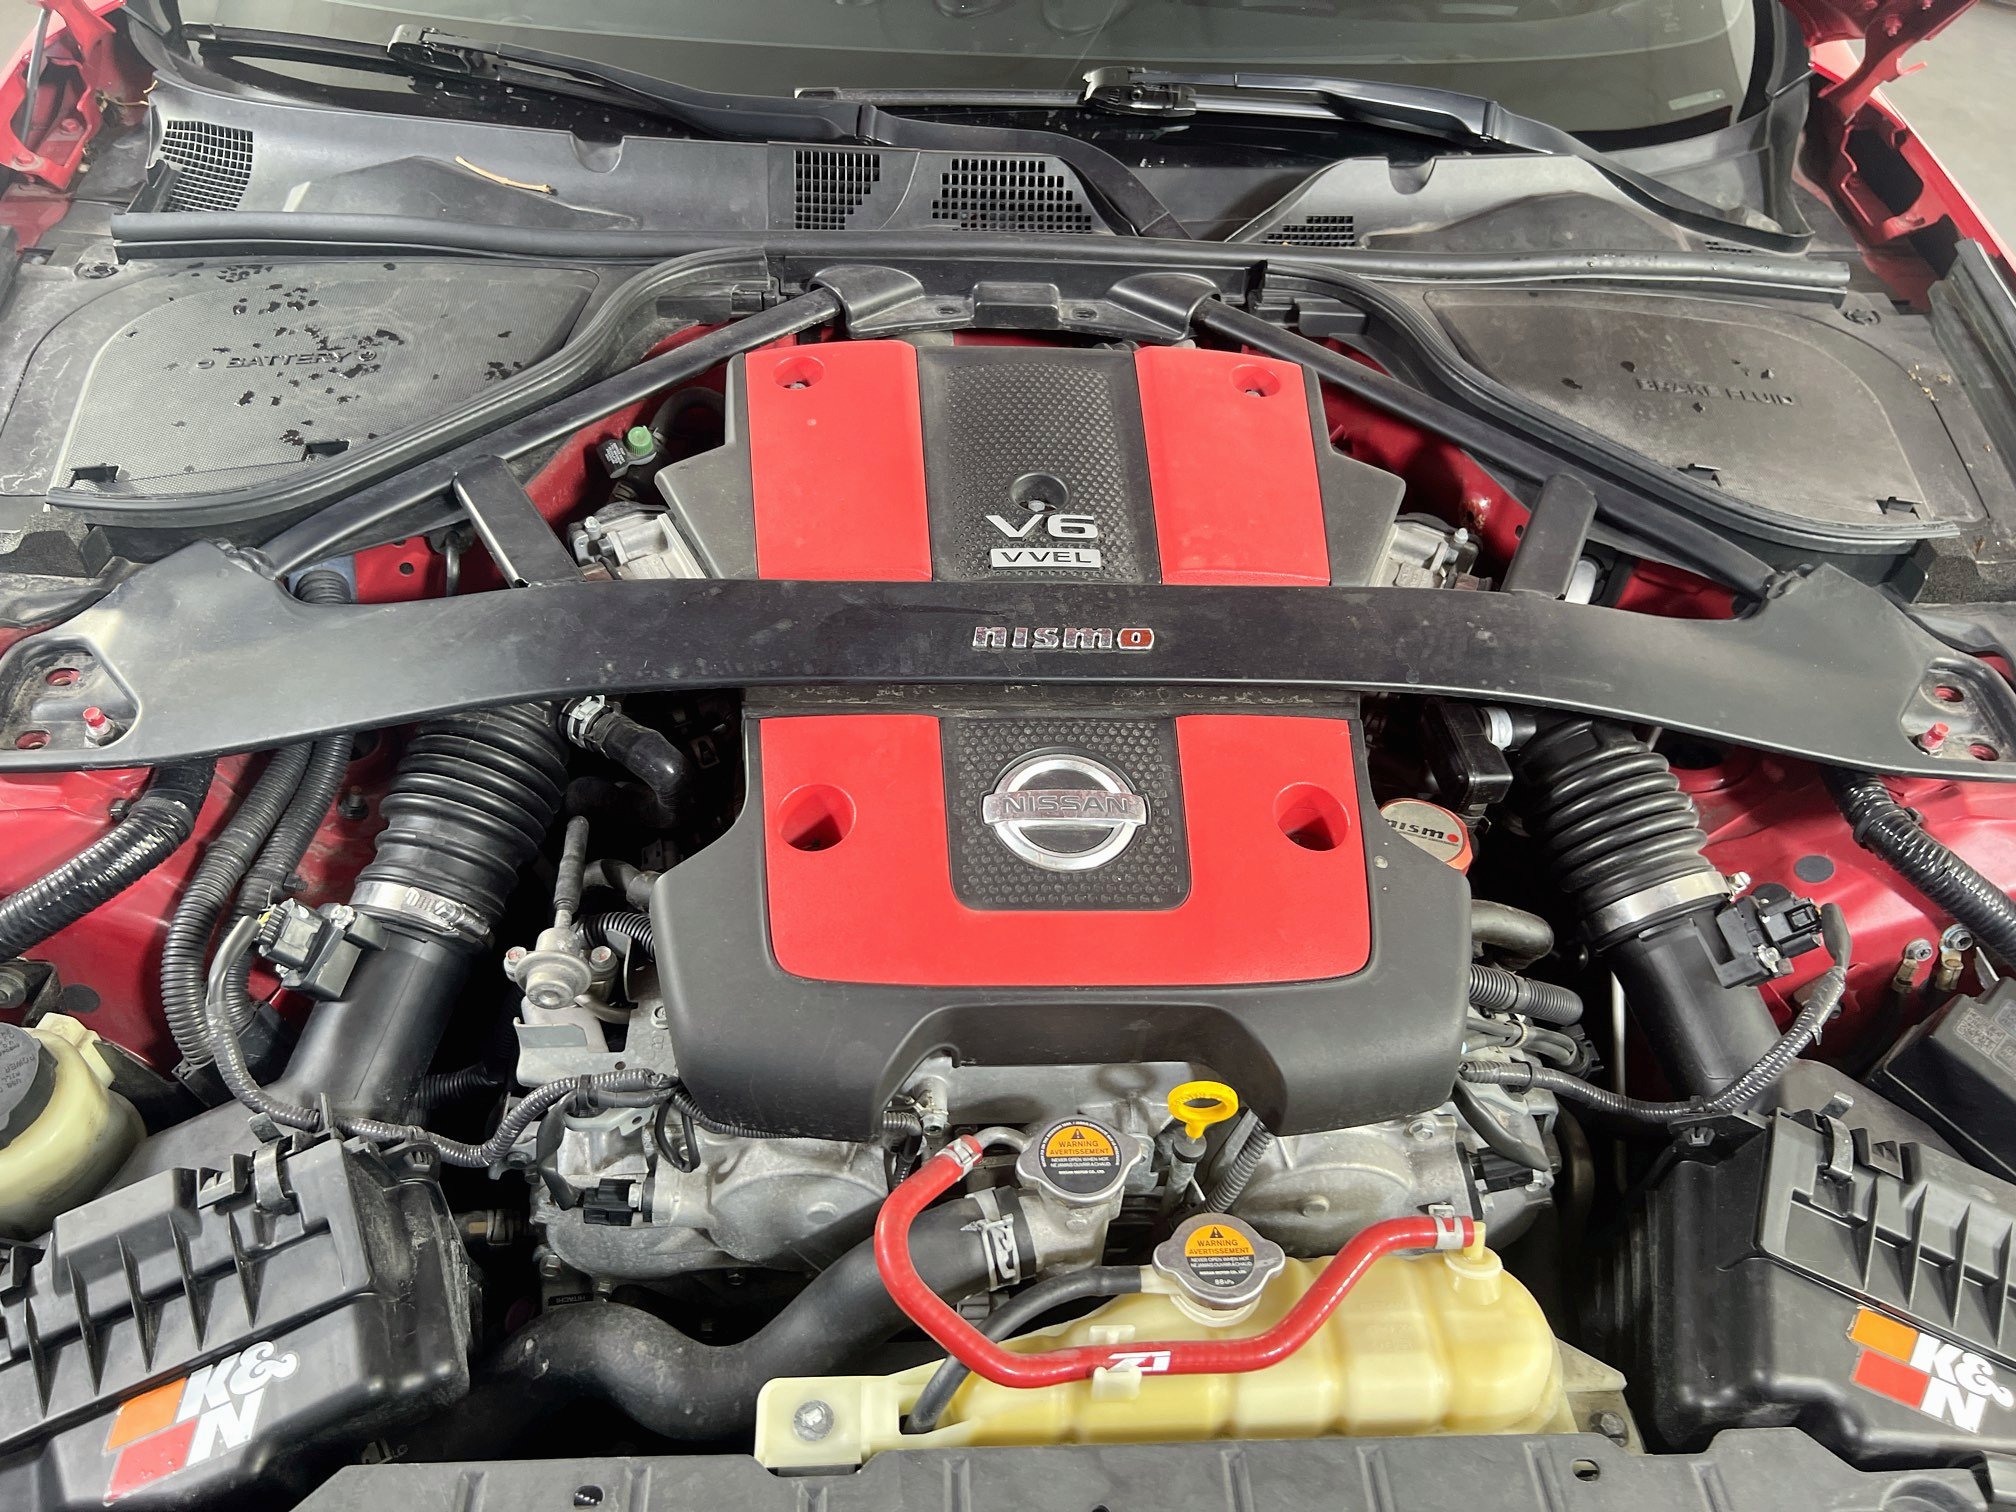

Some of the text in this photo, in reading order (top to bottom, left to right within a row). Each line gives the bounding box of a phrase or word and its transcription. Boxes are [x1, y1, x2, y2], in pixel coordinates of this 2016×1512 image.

[226, 351, 352, 368] BATTERY
[1636, 379, 1721, 397] BRAKE
[985, 514, 1099, 540] V6
[1001, 551, 1092, 564] VVEL
[1002, 796, 1129, 814] NISSAN
[1059, 1140, 1099, 1148] WARNING
[1189, 1247, 1249, 1255] AVERTISSEMENT
[1910, 1332, 2014, 1434] K&N
[175, 1341, 297, 1467] K&N
